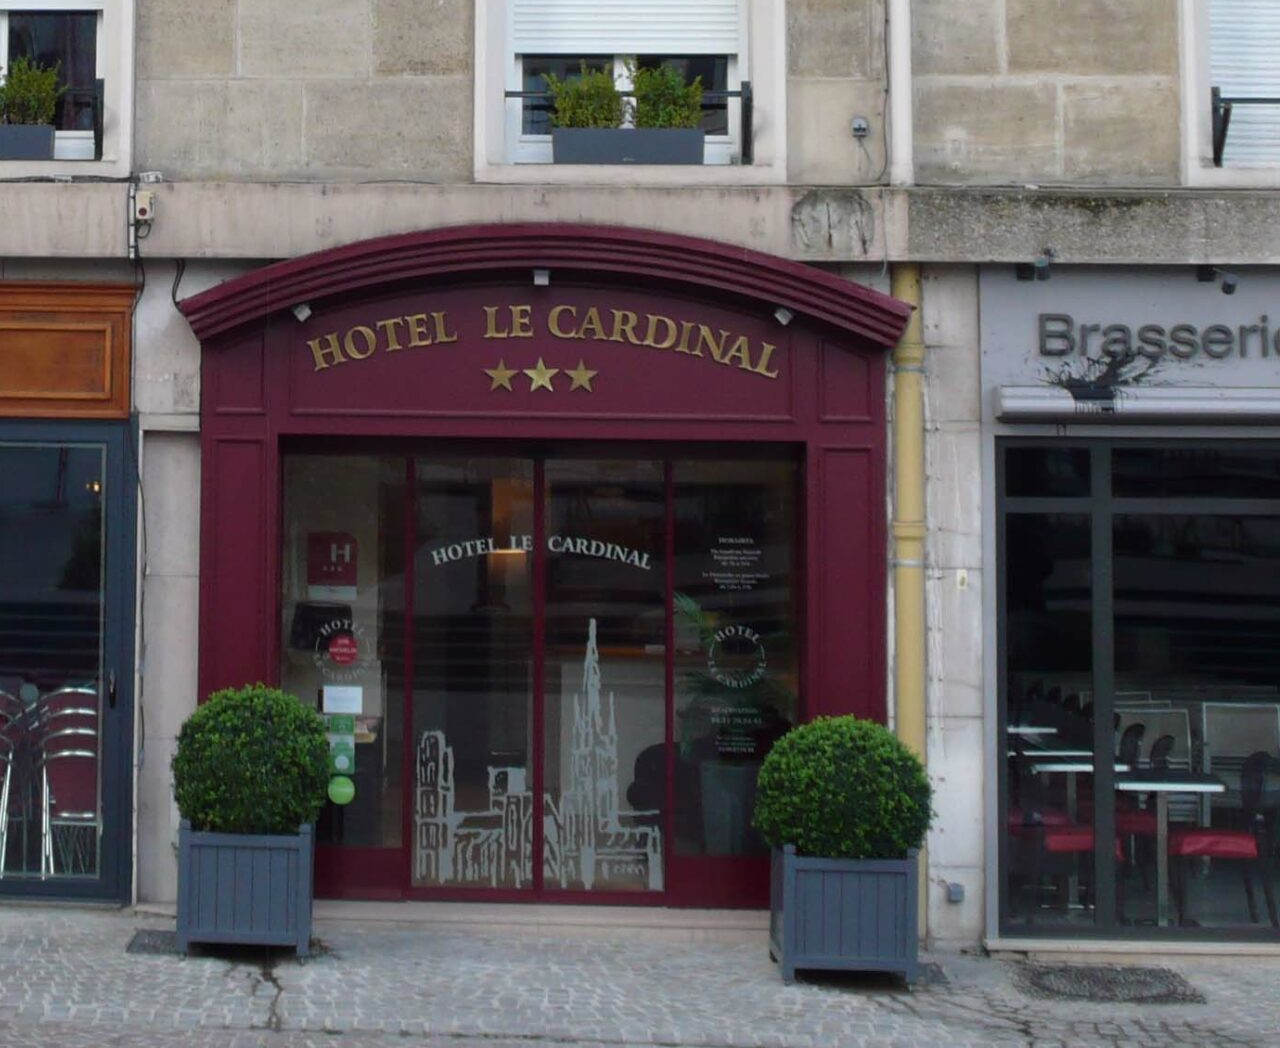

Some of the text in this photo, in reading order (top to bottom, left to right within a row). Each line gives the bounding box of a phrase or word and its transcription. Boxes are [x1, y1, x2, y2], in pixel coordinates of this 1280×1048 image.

[306, 304, 779, 380] HOTEL LE CARDINAL
[1038, 313, 1280, 359] Brasseri
[331, 543, 351, 564] H
[431, 535, 652, 571] HOTEL LE CARDINAL
[714, 625, 761, 644] HOTEL
